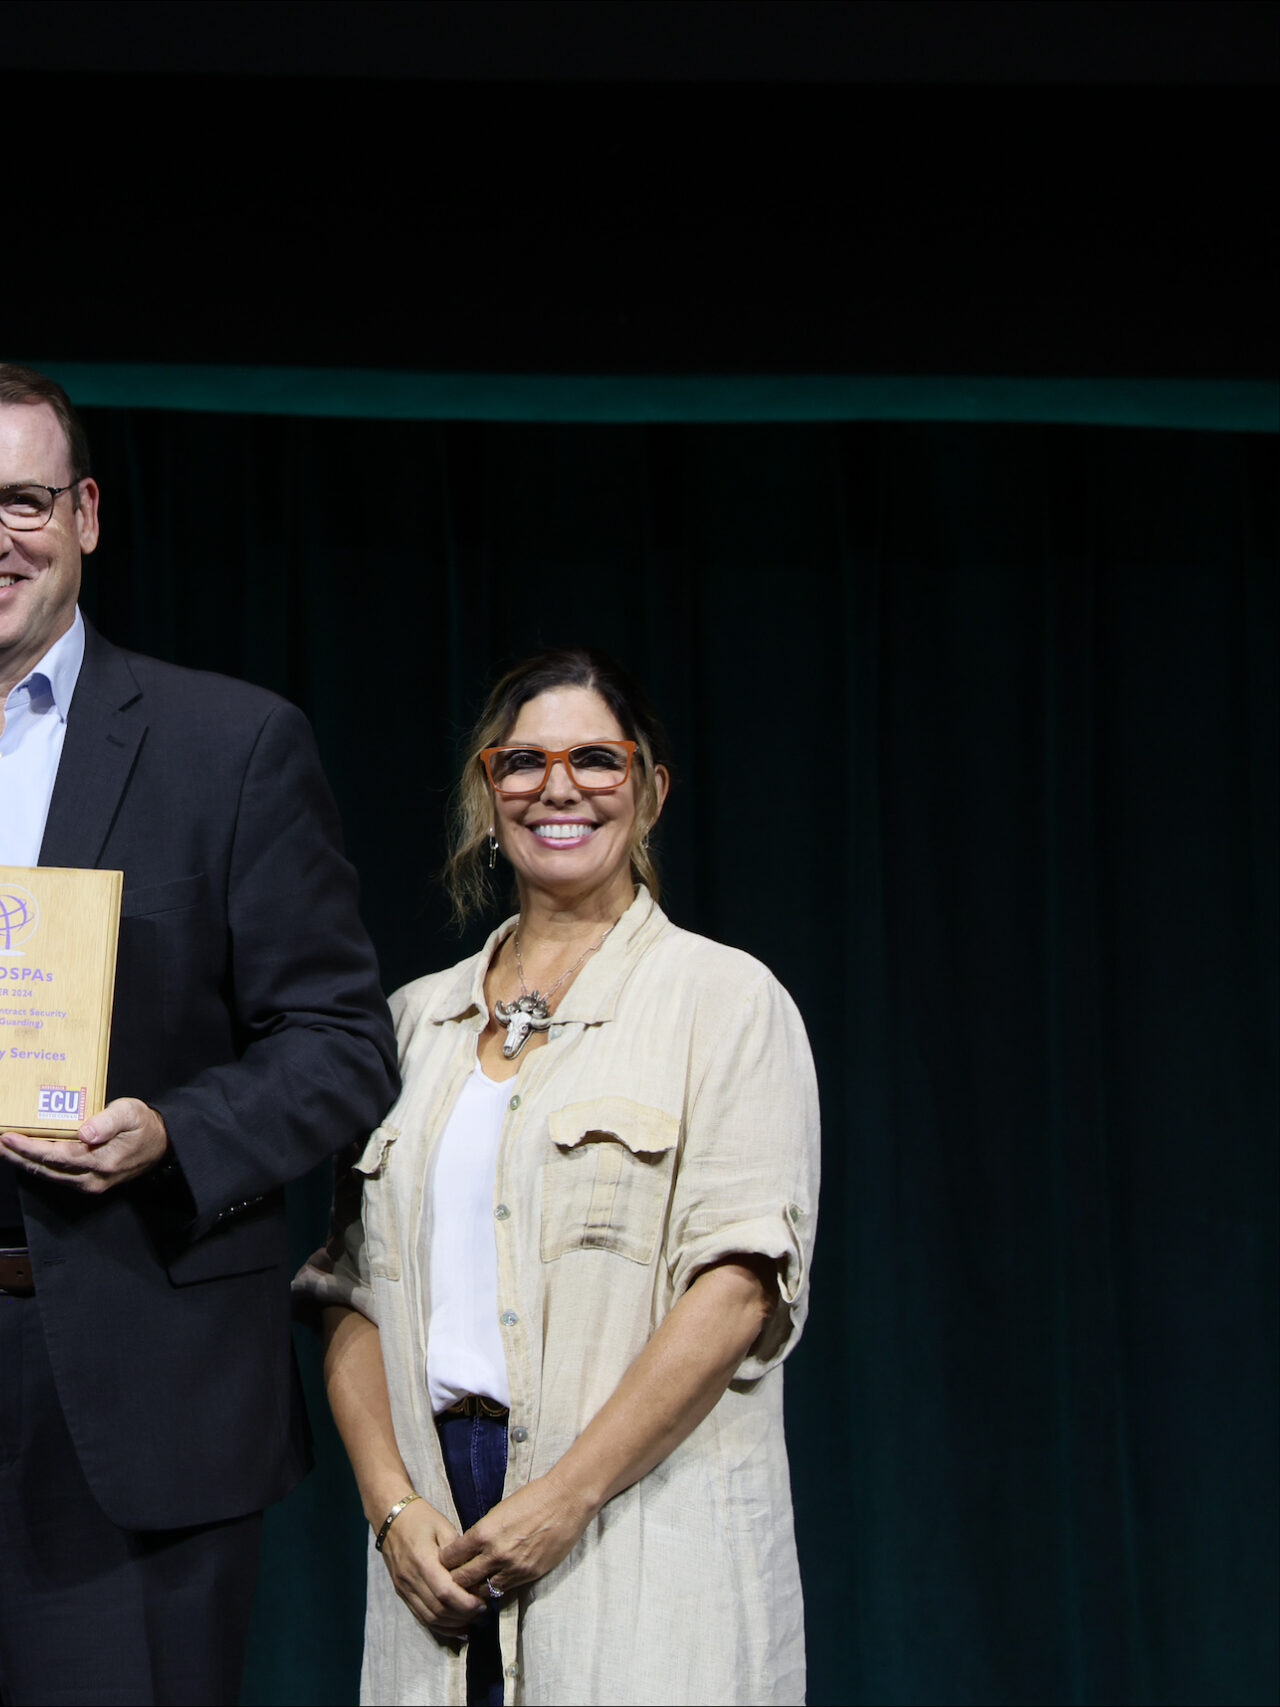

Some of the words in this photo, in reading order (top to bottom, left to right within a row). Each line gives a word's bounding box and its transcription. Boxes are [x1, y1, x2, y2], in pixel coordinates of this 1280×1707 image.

[12, 989, 33, 998] 2024
[29, 1008, 67, 1018] Security
[10, 1047, 67, 1061] Services
[38, 1090, 79, 1112] ECU
